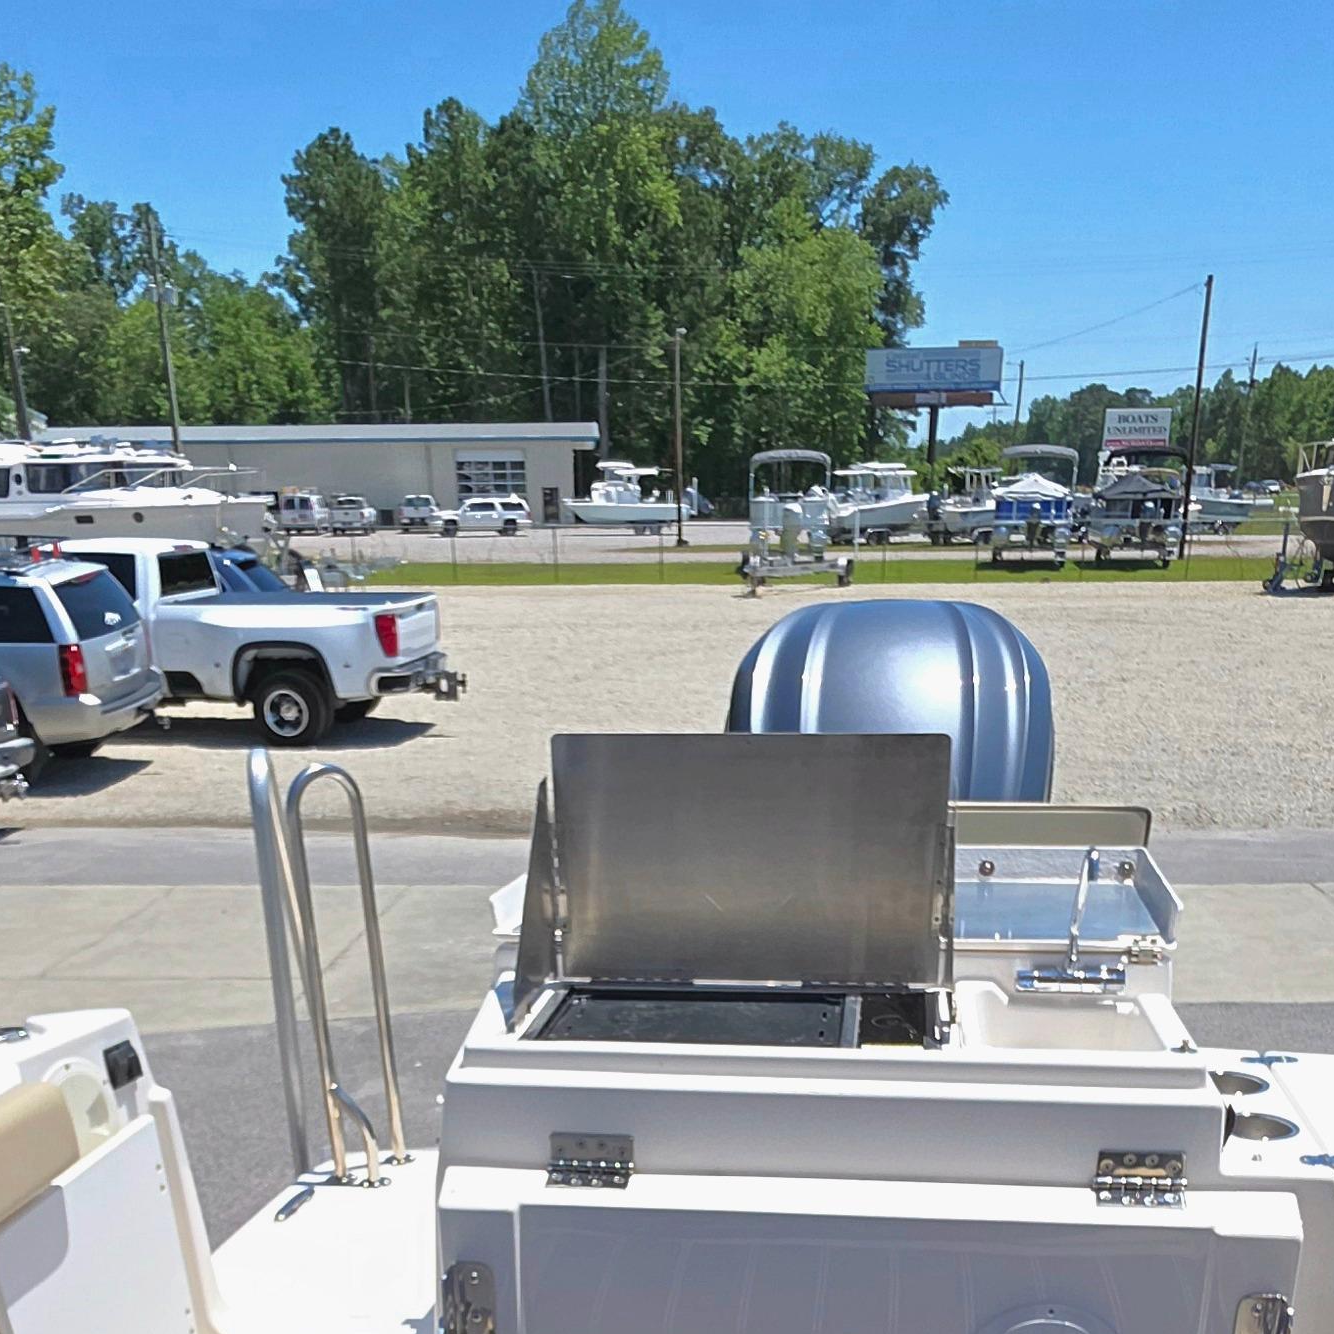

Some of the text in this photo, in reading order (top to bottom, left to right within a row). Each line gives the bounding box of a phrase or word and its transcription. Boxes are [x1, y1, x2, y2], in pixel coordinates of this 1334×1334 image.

[885, 358, 980, 374] SHUTTERS
[1117, 414, 1159, 424] BOATS
[1107, 426, 1167, 435] UNLIMITED
